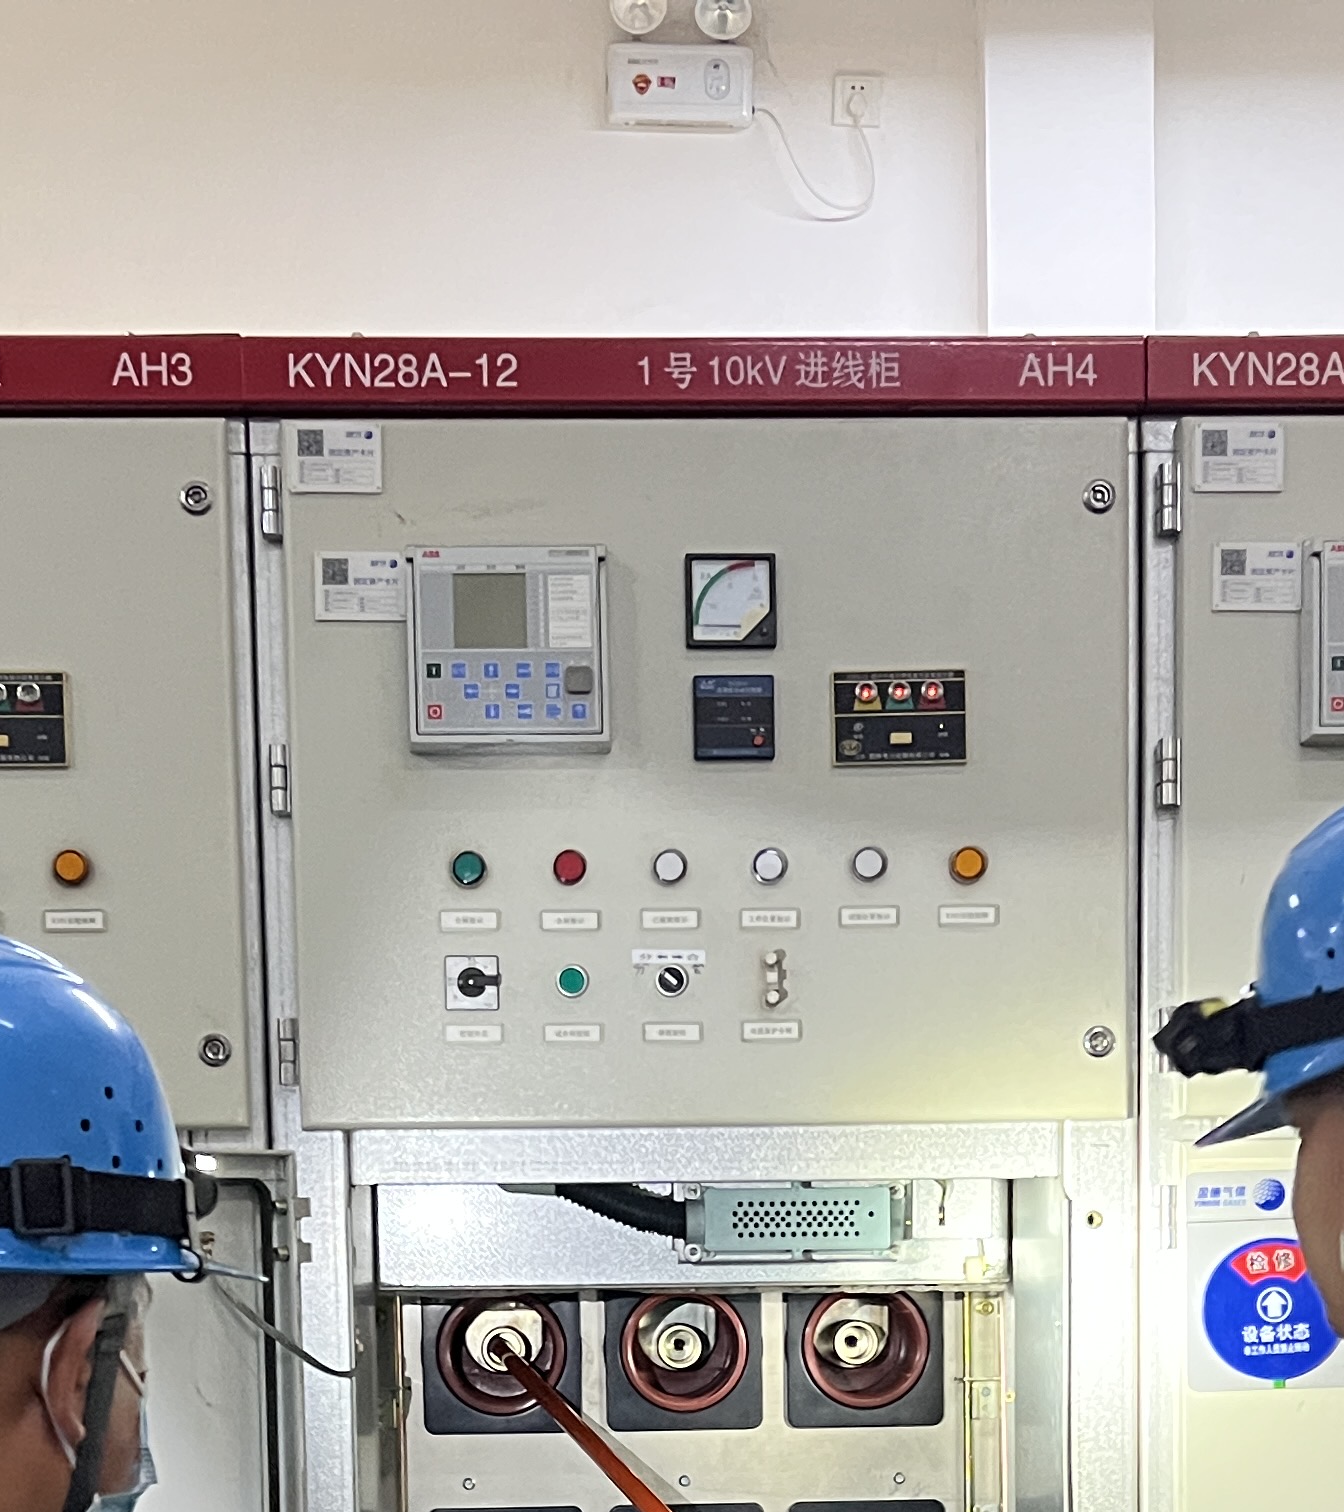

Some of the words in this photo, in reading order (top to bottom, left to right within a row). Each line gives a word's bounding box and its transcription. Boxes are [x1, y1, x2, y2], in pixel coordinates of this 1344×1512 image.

[112, 352, 193, 388] AH3
[288, 352, 518, 389] KYN28A-12
[1018, 352, 1098, 388] AH4
[1242, 1323, 1310, 1344] 设备状态
